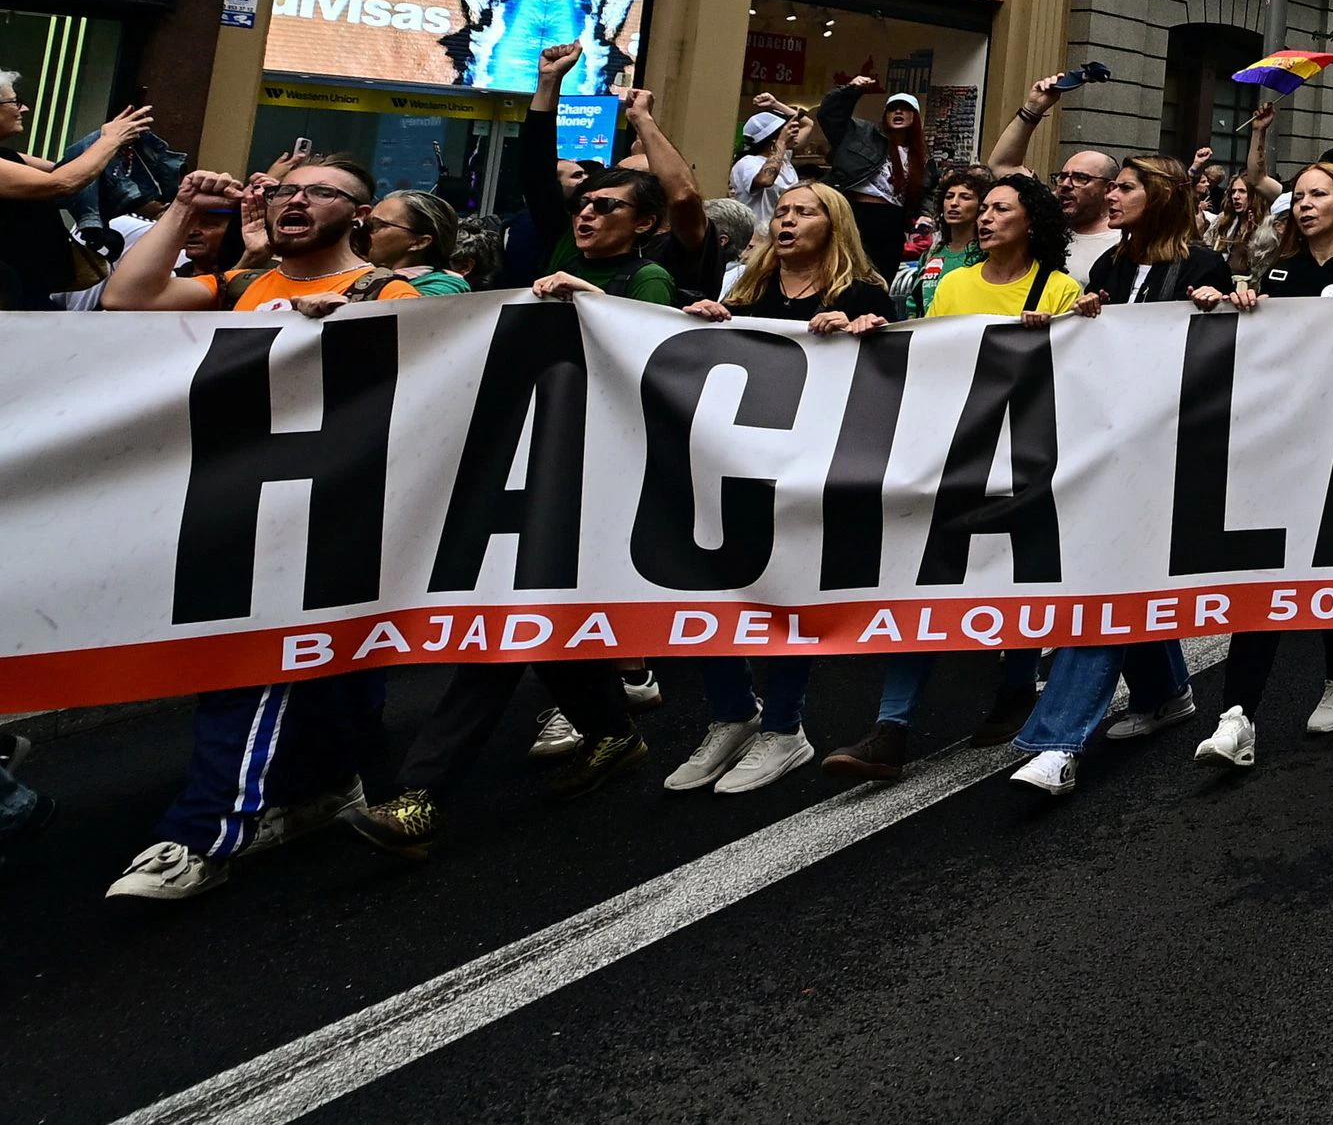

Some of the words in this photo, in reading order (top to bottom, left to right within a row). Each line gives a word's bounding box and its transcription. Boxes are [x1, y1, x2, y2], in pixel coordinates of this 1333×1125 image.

[286, 89, 328, 103] Western
[329, 91, 360, 105] Union
[410, 99, 447, 111] Western
[448, 101, 474, 113] Union
[557, 103, 603, 117] Change
[556, 115, 595, 129] Money
[170, 302, 1063, 625] HACIA
[281, 611, 619, 672] BAJADA
[667, 608, 821, 646] DEL
[857, 592, 1233, 647] ALQUILER
